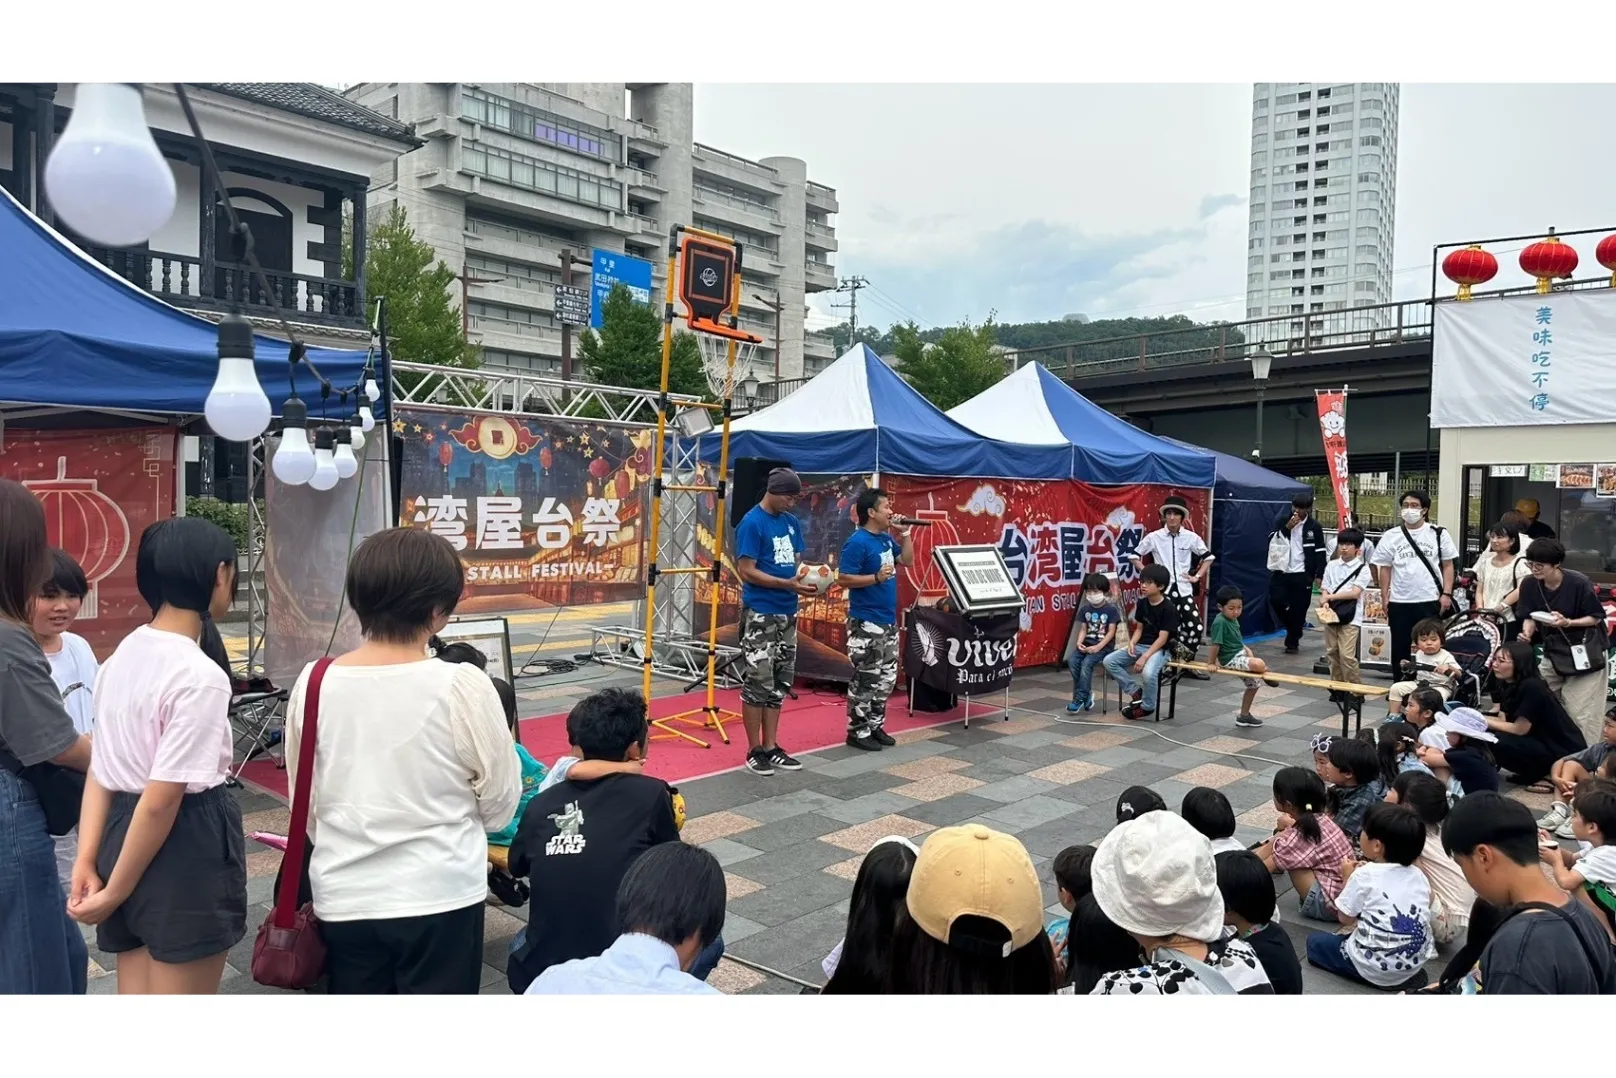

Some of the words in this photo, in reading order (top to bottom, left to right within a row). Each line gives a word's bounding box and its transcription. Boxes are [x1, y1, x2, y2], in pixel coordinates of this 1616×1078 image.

[1529, 306, 1553, 411] 美味吃不停
[414, 494, 621, 551] 湾屋台祭
[1000, 524, 1144, 585] 台湾屋台祭
[467, 564, 521, 581] STALL
[956, 668, 984, 684] Para
[550, 834, 585, 845] STAR
[545, 842, 586, 856] WARS
